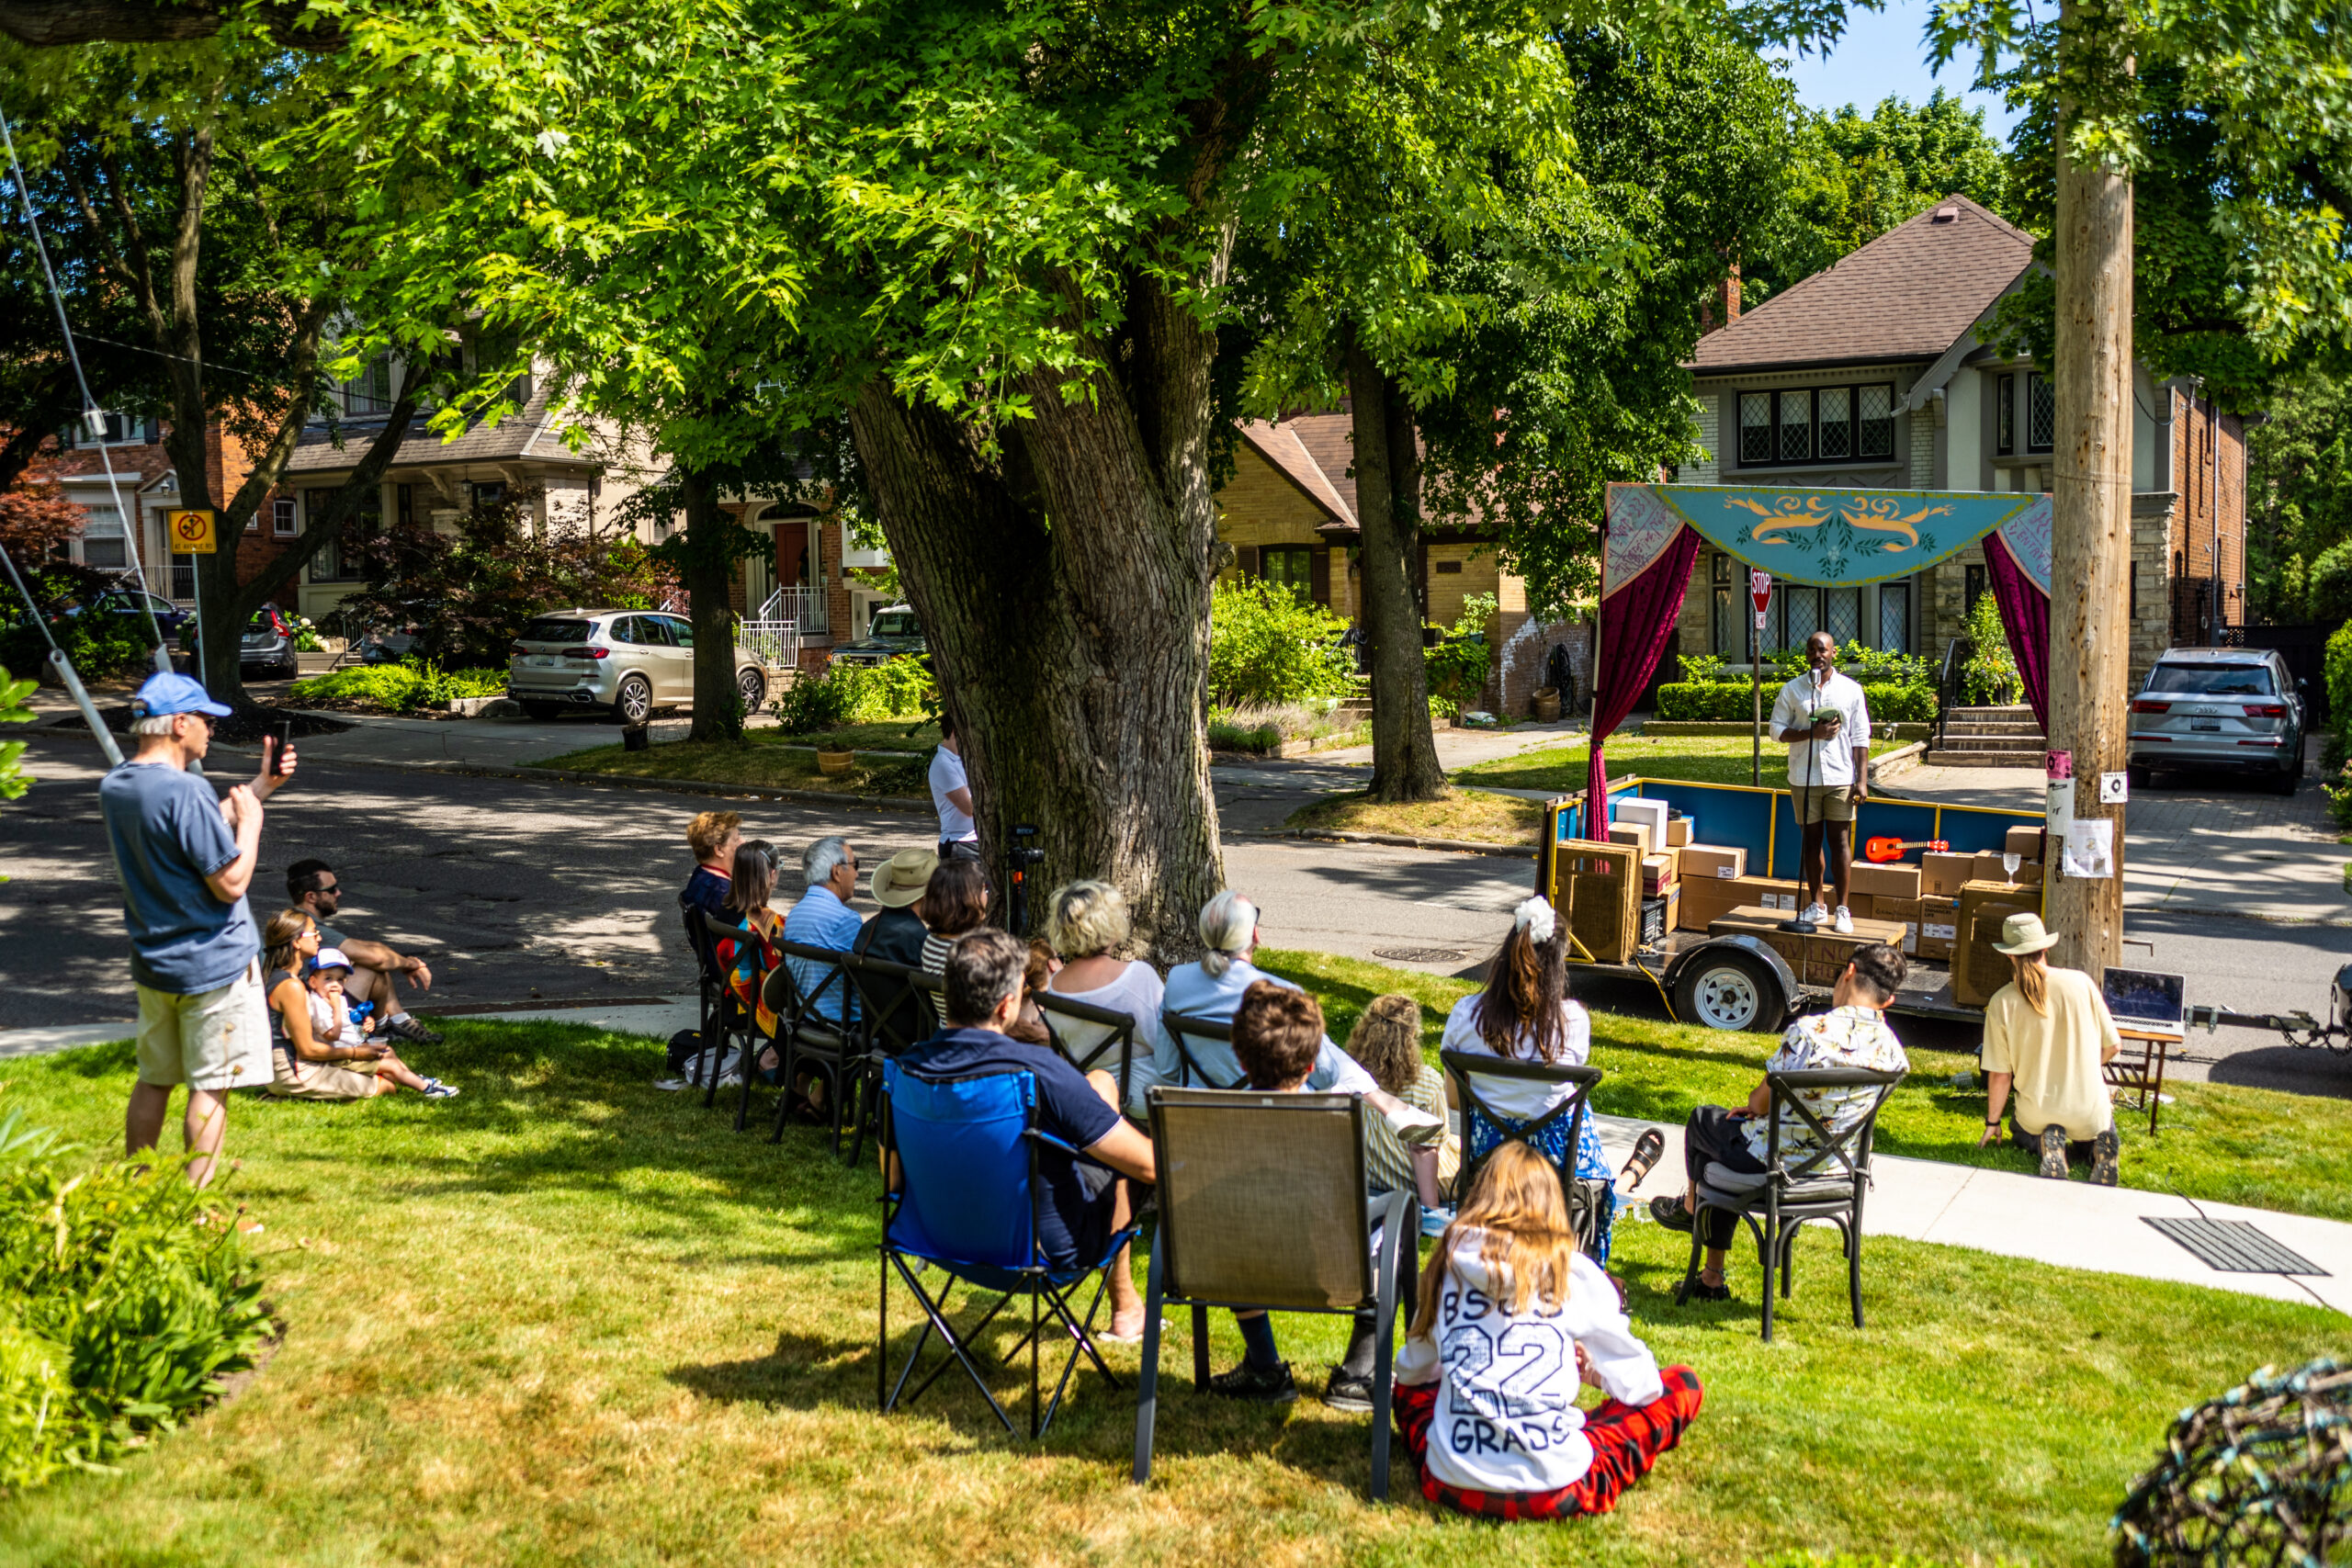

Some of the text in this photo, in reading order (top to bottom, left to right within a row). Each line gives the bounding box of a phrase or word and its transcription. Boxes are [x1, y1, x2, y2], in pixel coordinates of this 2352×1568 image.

[1752, 571, 1770, 594] STOP
[1771, 940, 1852, 962] OVING
[1440, 1323, 1566, 1419] 22
[1450, 1416, 1570, 1455] GRADS
